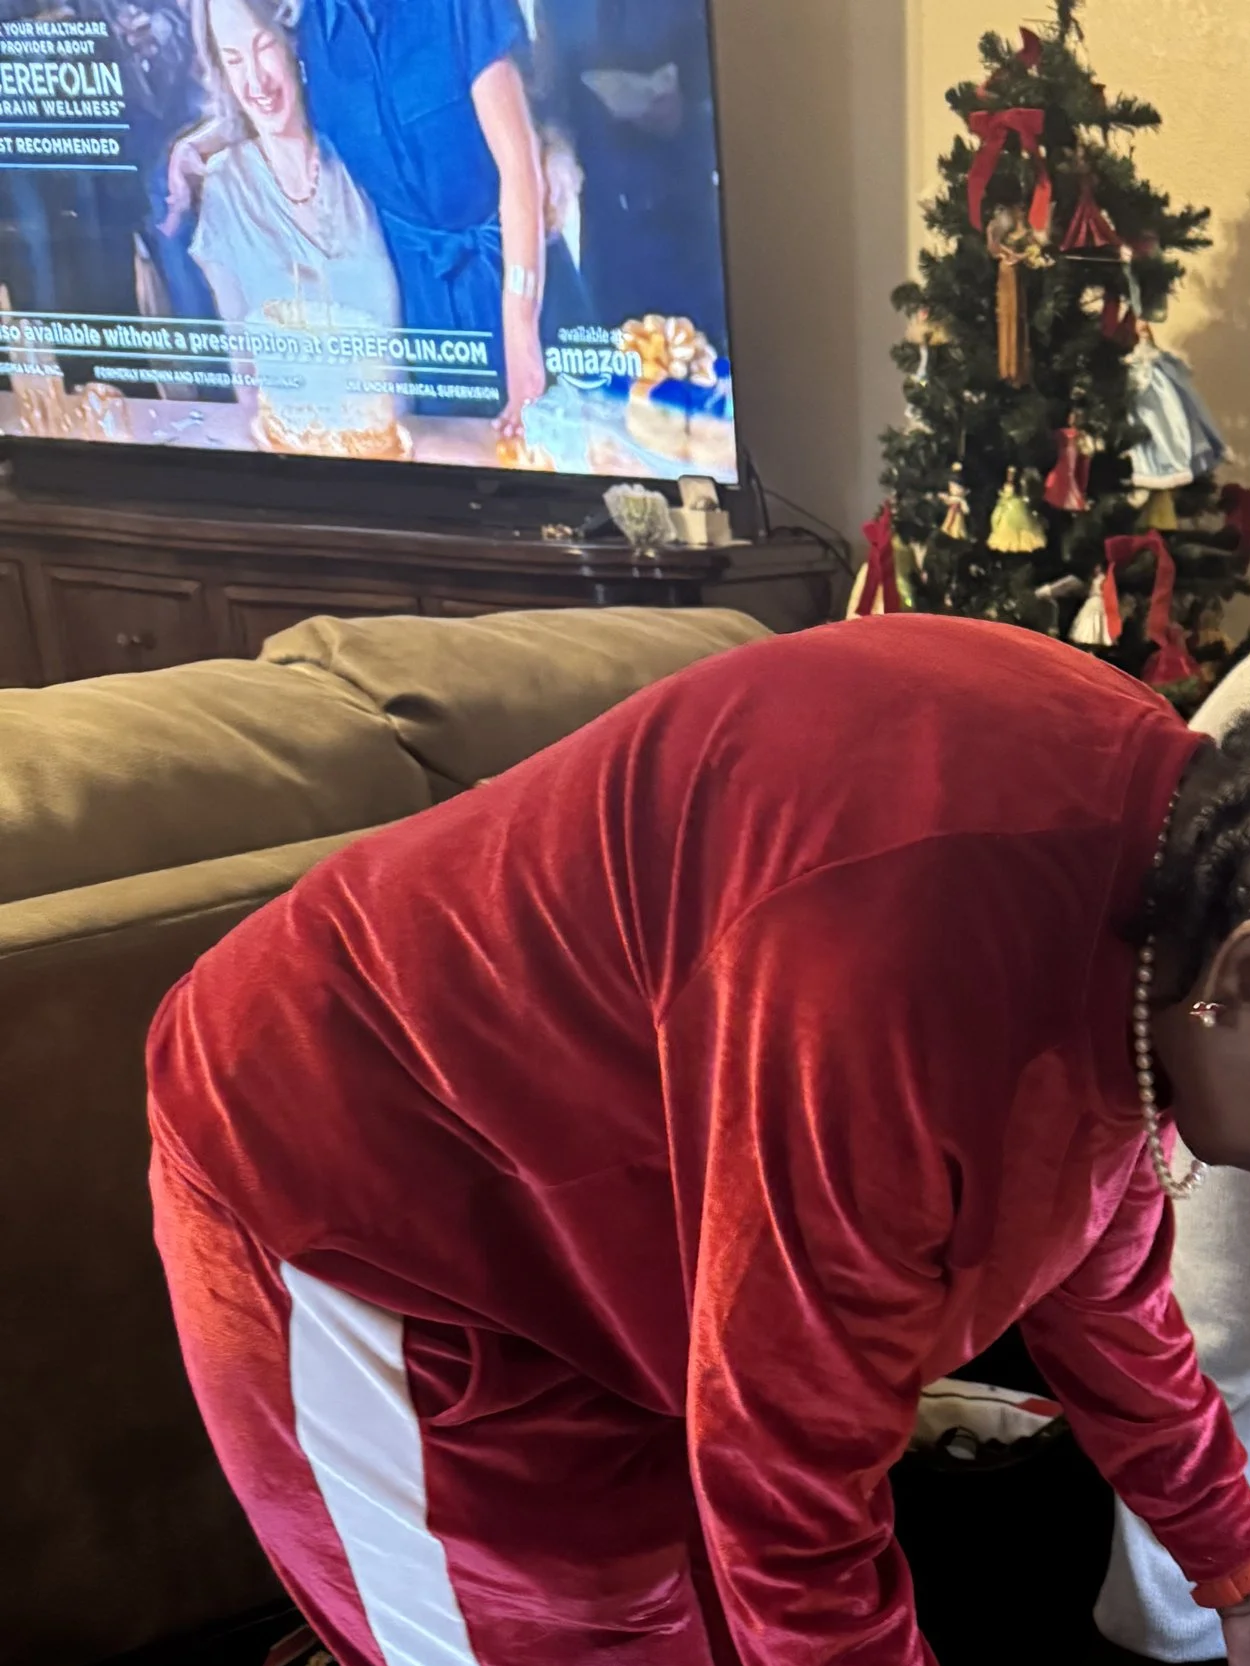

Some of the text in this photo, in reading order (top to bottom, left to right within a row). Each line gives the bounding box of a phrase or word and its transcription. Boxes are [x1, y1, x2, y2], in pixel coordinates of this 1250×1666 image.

[2, 22, 109, 37] YOUR HEALTHCARE
[0, 40, 95, 55] PROVIDER ABOUT
[0, 62, 124, 96] EREFOLIN
[15, 137, 120, 155] RECOMMENDED
[558, 326, 609, 343] available
[24, 323, 100, 345] available
[102, 325, 173, 350] without
[174, 334, 187, 349] a
[189, 331, 299, 355] prescription
[303, 339, 321, 354] at
[327, 337, 488, 364] CEREFOLIN.COM
[546, 347, 642, 377] amazon
[396, 383, 436, 397] MEDICAL
[438, 385, 499, 400] SUPERVISION
